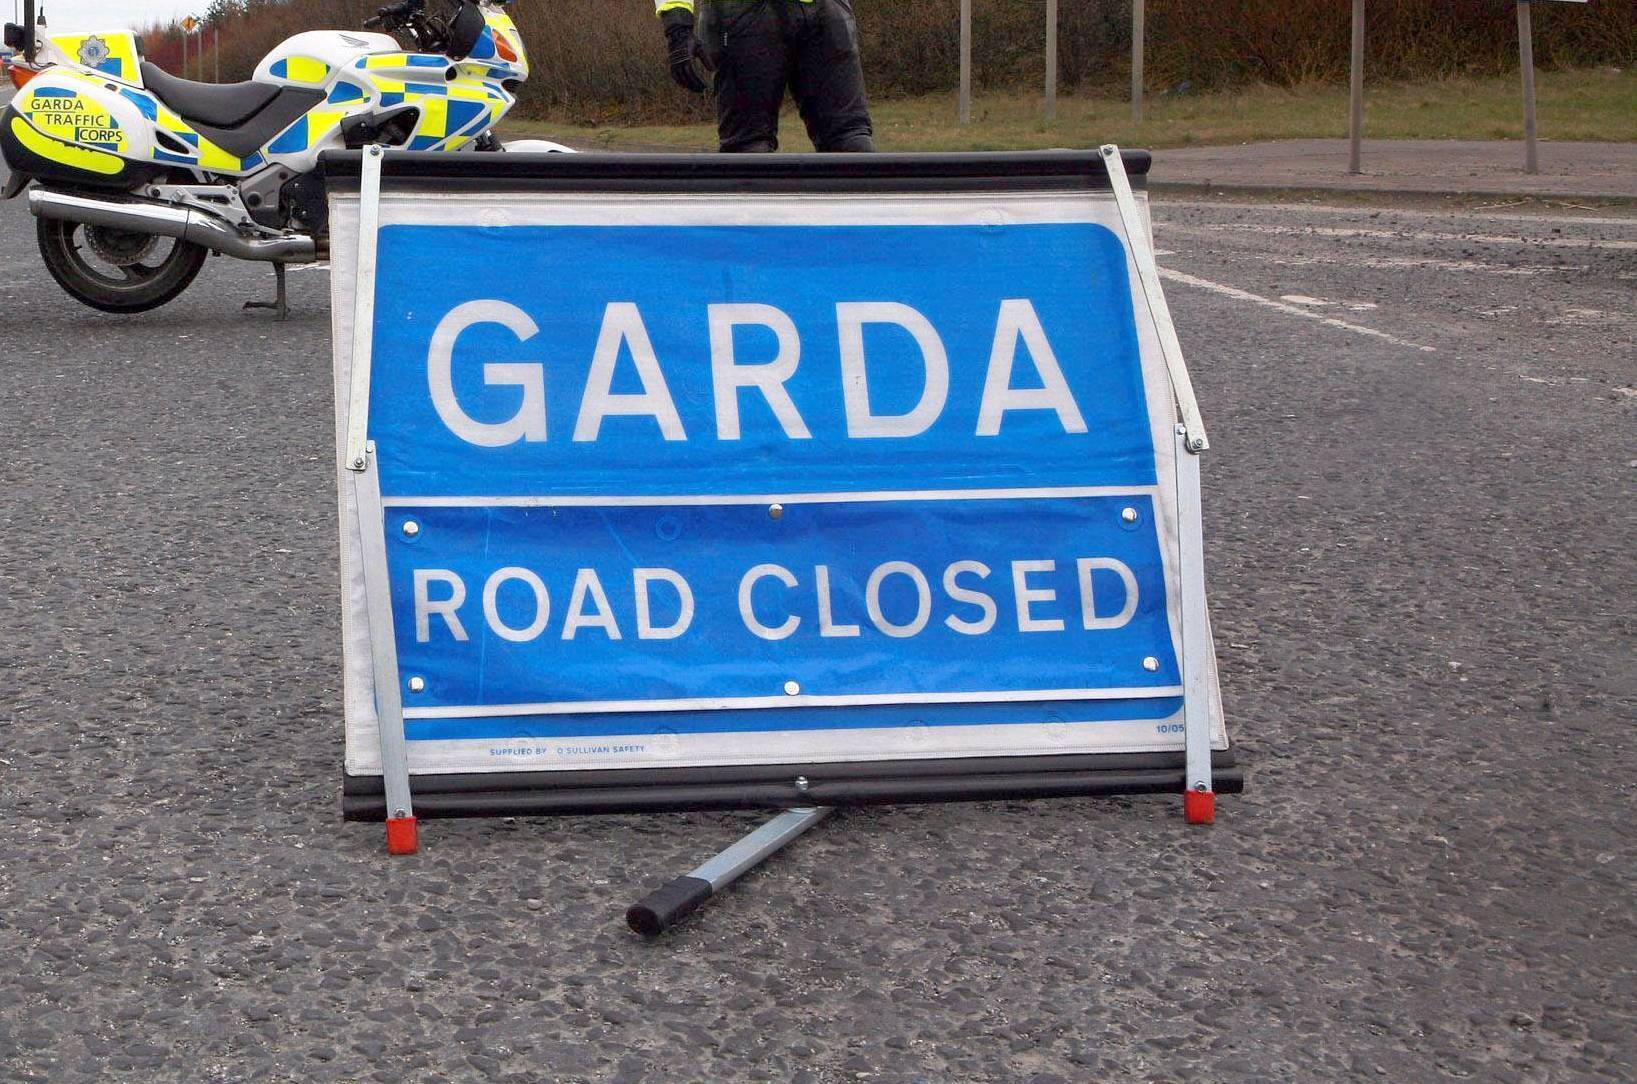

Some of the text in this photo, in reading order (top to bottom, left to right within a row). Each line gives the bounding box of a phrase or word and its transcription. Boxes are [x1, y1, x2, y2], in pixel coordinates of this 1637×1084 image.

[30, 98, 84, 111] GARDA
[44, 113, 105, 127] TRAFFIC
[79, 128, 123, 142] CORPS
[427, 298, 1089, 448] GARDA
[413, 557, 1139, 642] ROAD CLOSED
[1156, 723, 1185, 734] 10/05
[489, 748, 533, 757] SUPPLIED
[535, 747, 547, 756] BY
[612, 745, 645, 754] SAFETY
